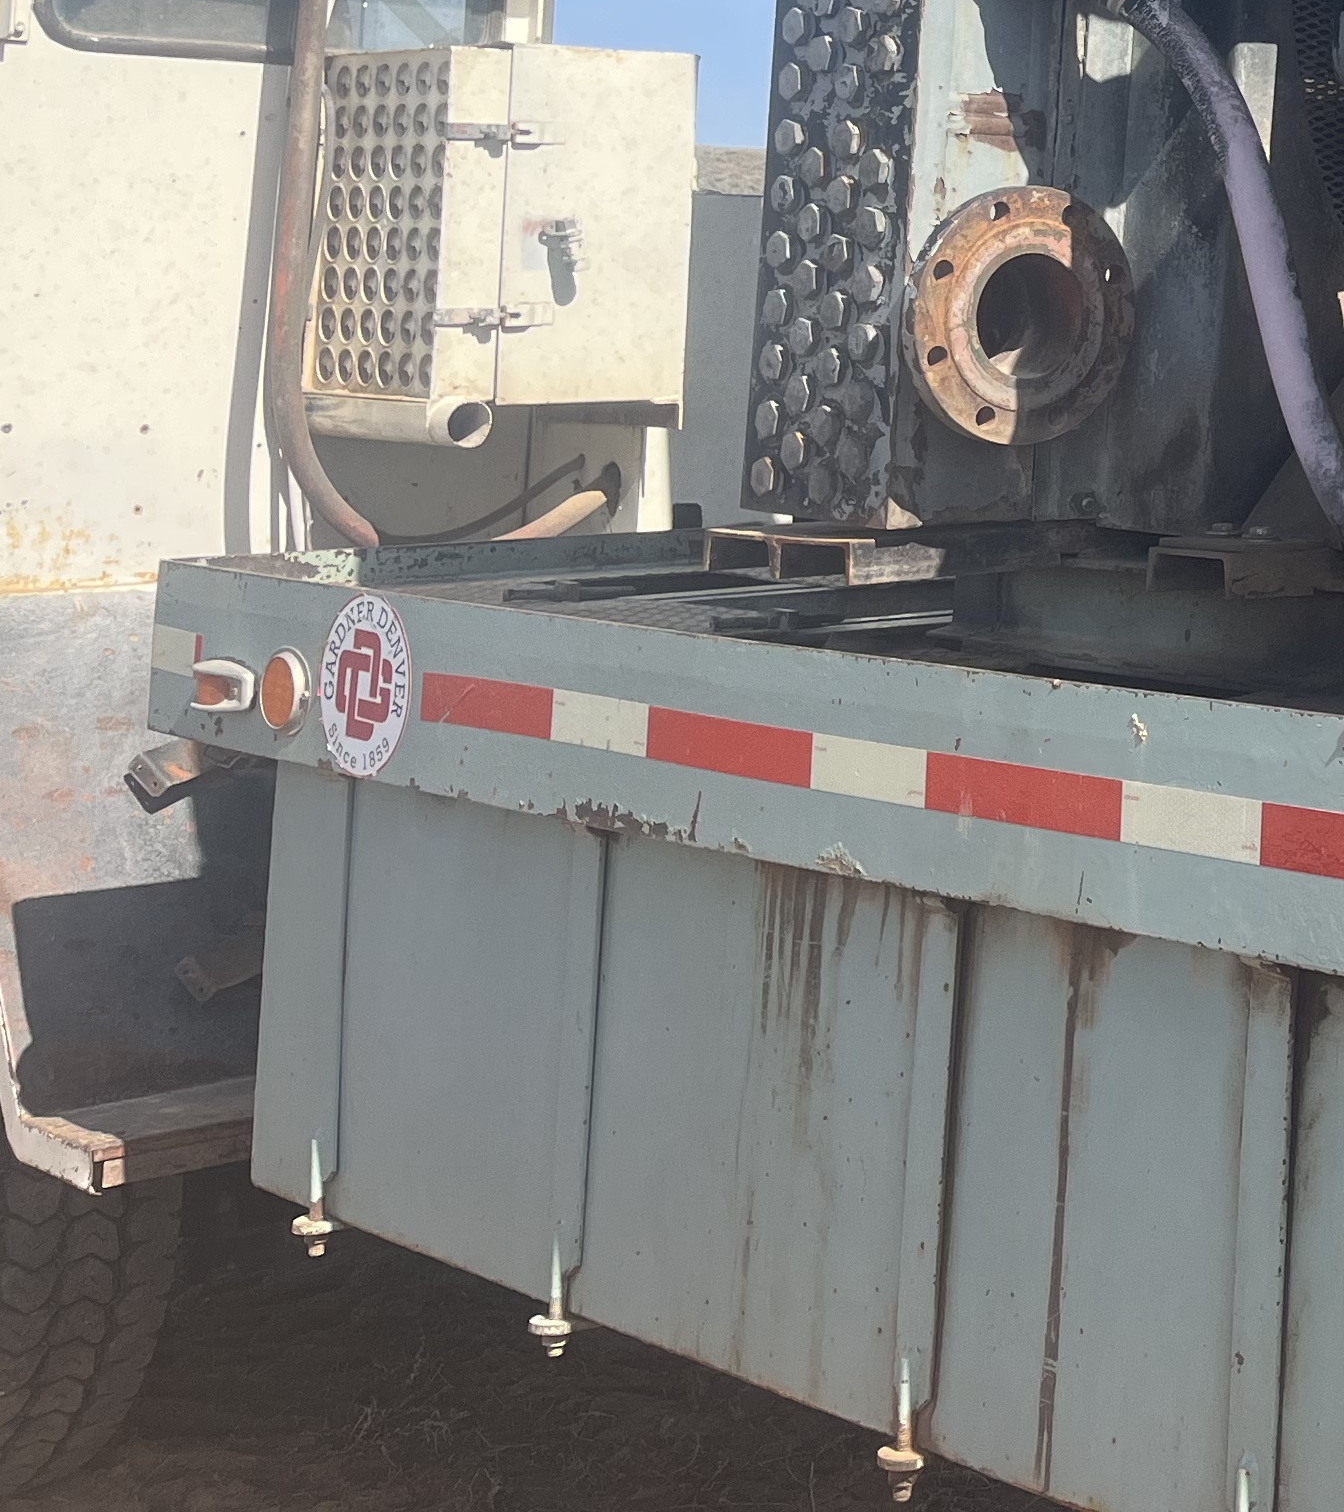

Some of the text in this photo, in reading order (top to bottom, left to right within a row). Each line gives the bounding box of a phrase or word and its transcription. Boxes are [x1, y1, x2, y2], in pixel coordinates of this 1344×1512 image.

[323, 600, 406, 719] GARDNER DENVER
[328, 722, 390, 770] Since 1859
